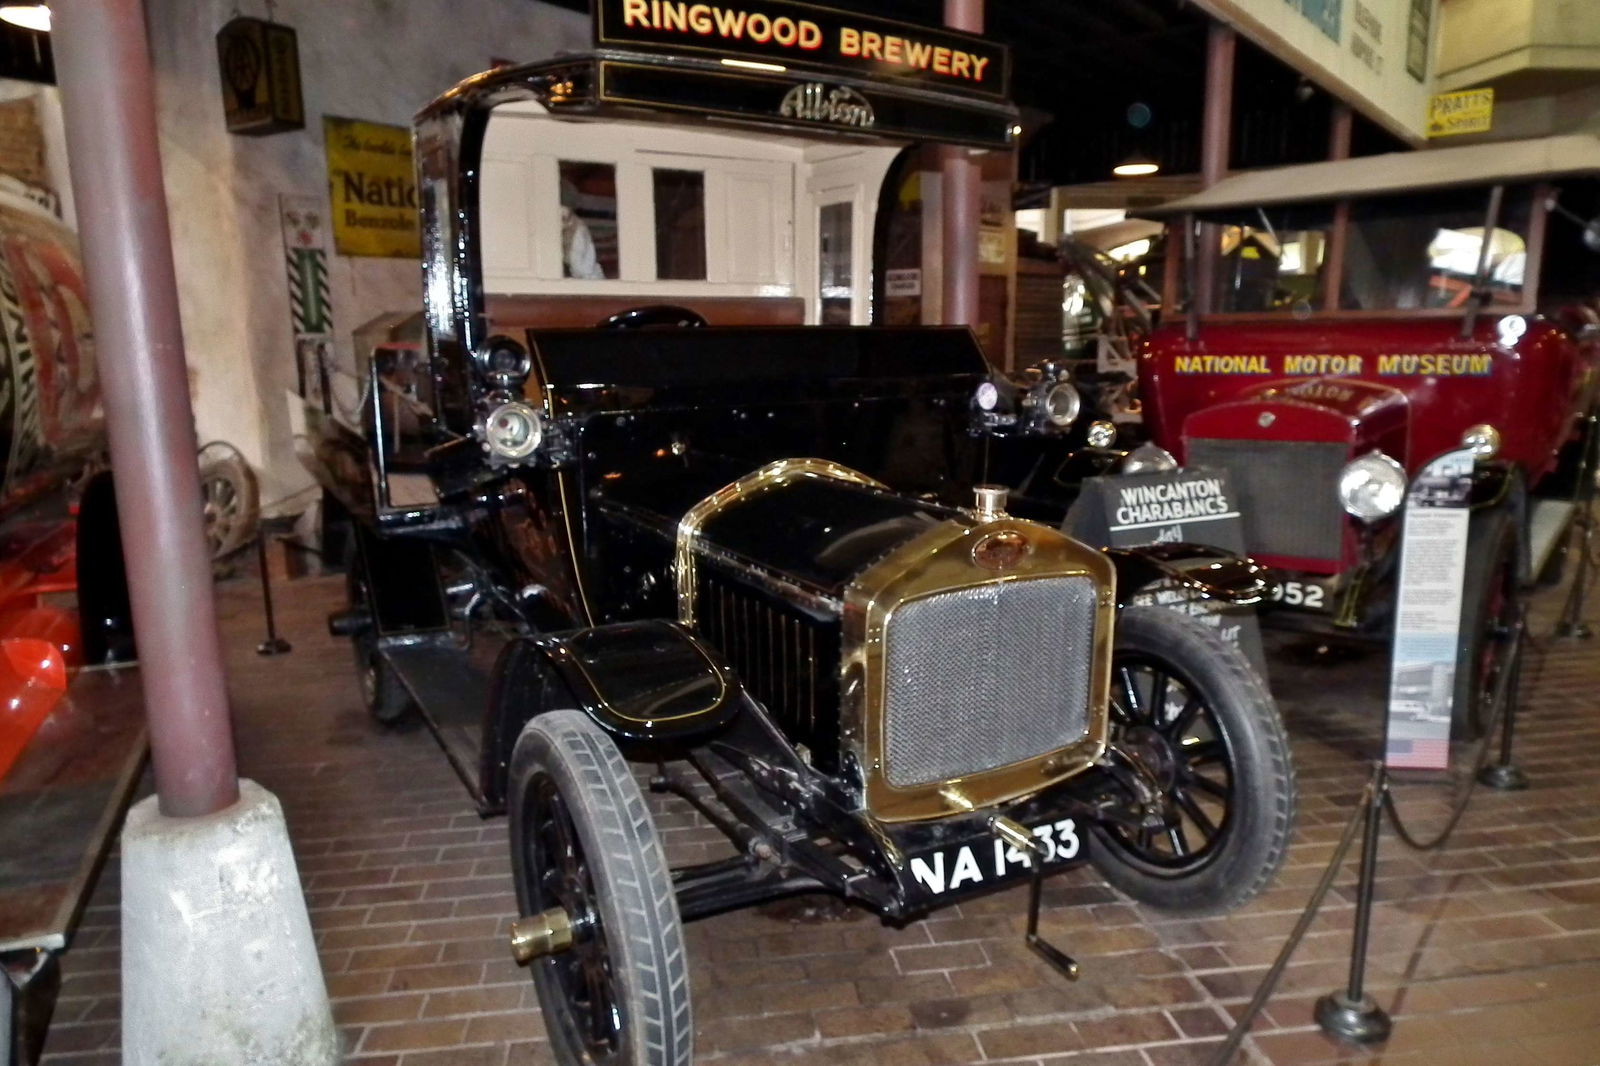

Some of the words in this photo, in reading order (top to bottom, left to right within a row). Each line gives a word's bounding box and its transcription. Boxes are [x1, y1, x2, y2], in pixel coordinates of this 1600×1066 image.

[623, 0, 822, 50] RINGWOOD
[839, 27, 990, 82] BREWERY
[780, 83, 875, 127] Albion
[1174, 355, 1270, 375] NATIONAL
[1284, 354, 1364, 376] MOTOR
[1378, 353, 1492, 376] MUSEUM
[1115, 495, 1229, 525] CHARABANCS
[1119, 478, 1221, 507] WINCANTON
[910, 845, 984, 895] NA
